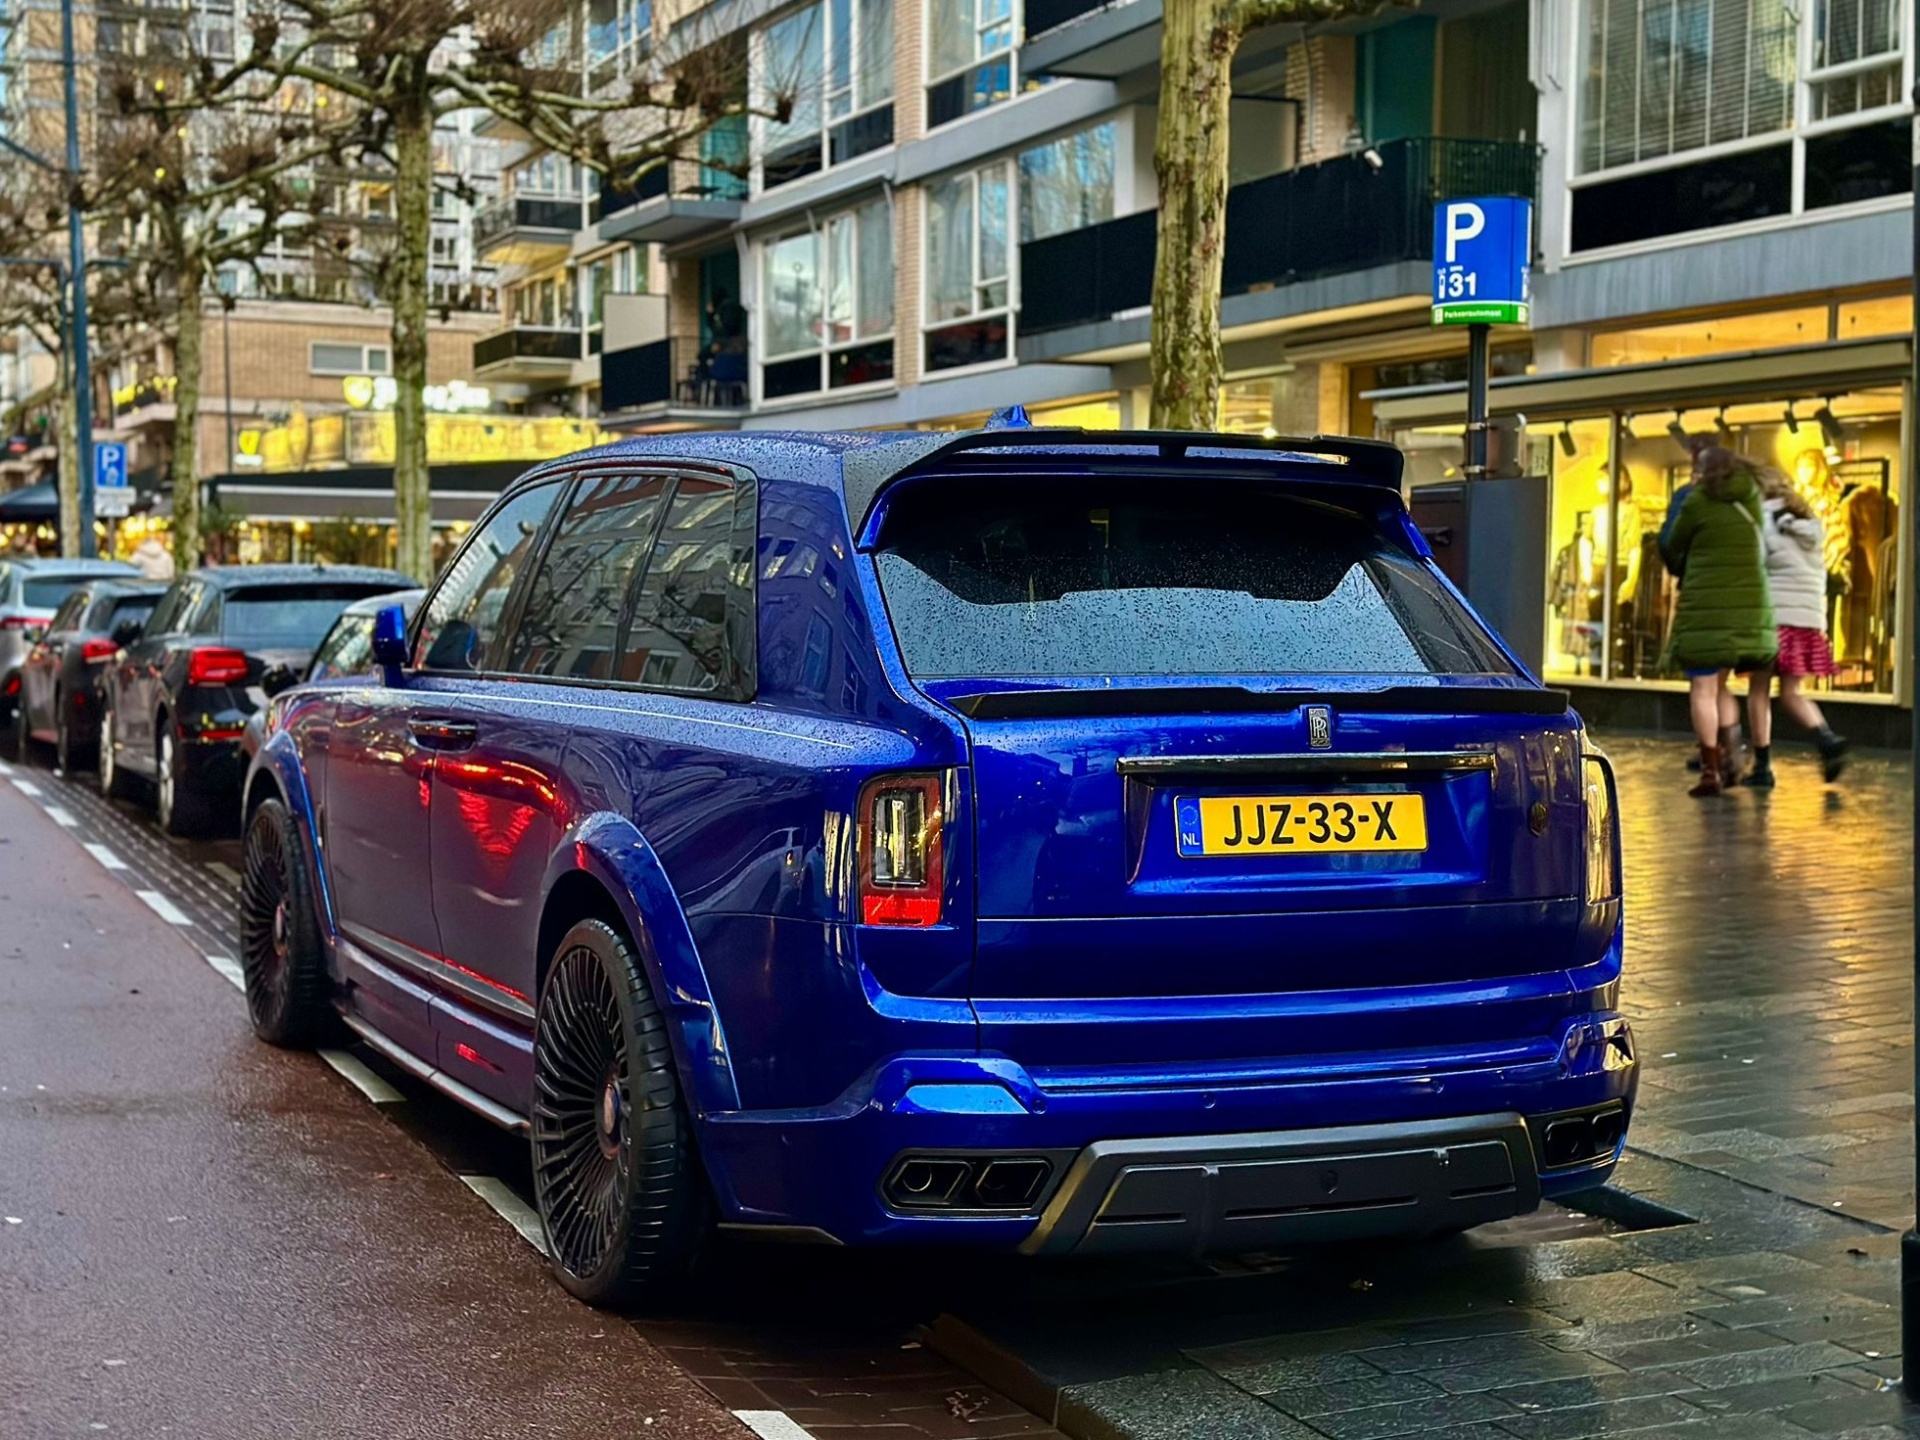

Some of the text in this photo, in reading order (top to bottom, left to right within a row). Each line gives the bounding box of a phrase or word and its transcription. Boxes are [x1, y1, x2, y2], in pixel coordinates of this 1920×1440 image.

[1445, 202, 1486, 263] P
[1448, 272, 1477, 298] 31
[101, 446, 121, 471] P
[1182, 801, 1398, 847] NL JJZ-33-X
